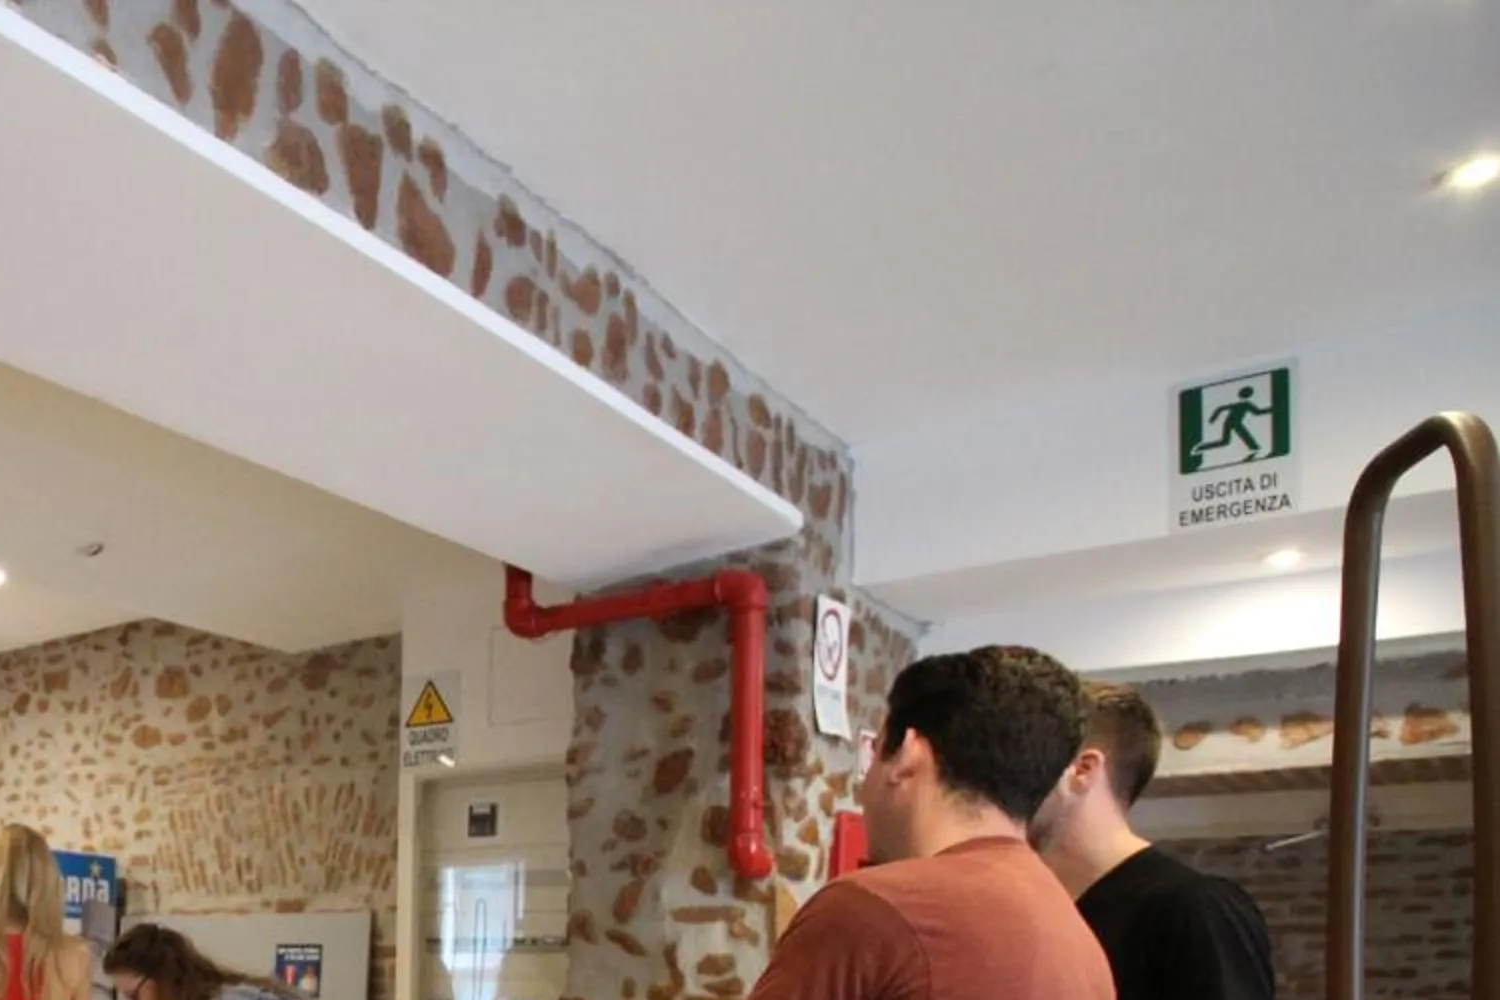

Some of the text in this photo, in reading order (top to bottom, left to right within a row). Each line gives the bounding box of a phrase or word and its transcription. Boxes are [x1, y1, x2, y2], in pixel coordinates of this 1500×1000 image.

[1191, 472, 1278, 502] USCITA DI
[1179, 493, 1291, 527] EMERGENZA
[409, 727, 450, 746] QUADRO
